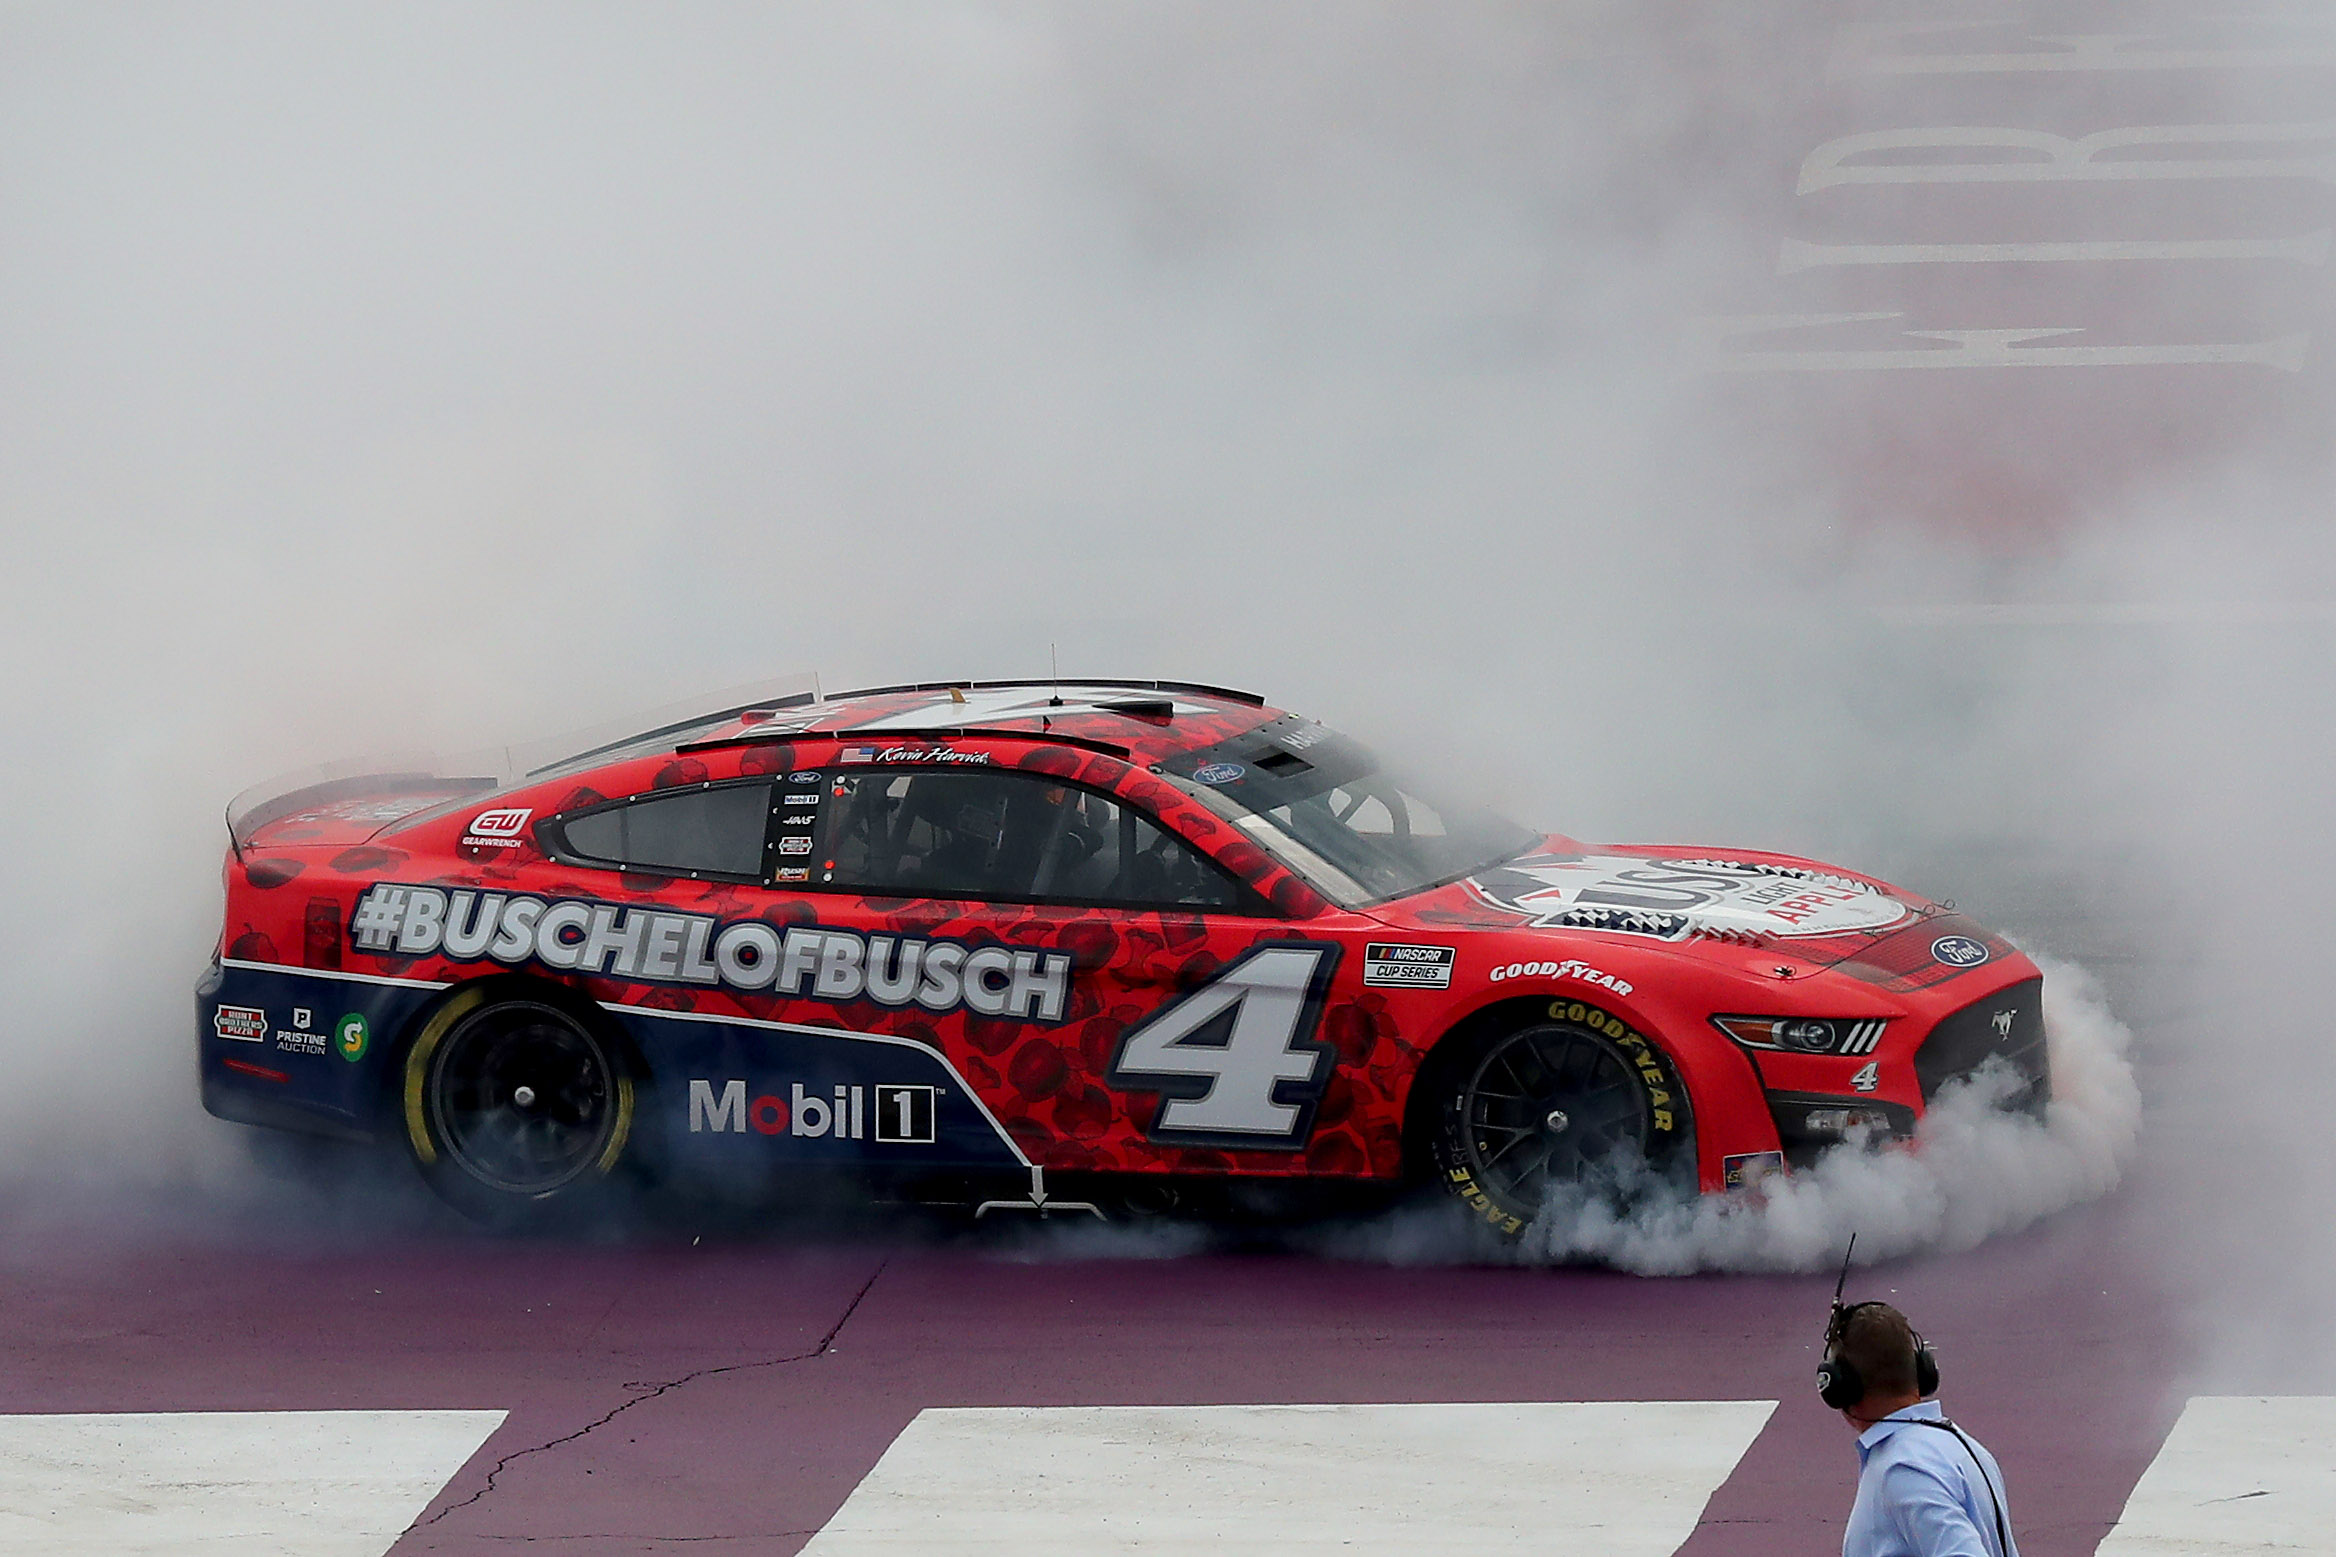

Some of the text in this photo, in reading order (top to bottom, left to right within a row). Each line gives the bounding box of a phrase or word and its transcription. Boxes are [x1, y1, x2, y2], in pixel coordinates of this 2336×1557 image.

[876, 747, 990, 764] Kevin Harvick
[1202, 766, 1238, 782] Ford
[462, 836, 522, 848] GEARWRENCH
[353, 884, 1071, 1021] #BUSCHELOFBUSCH
[1393, 947, 1442, 962] NASCAR
[1939, 940, 1983, 963] Ford
[1376, 965, 1440, 979] CUP SERIES
[1490, 959, 1634, 997] GOODYEAR
[276, 1030, 327, 1046] PRISTINE
[276, 1041, 326, 1055] AUCTION
[1115, 948, 1325, 1135] 4
[1548, 1001, 1673, 1132] GOODYEAR
[1849, 1061, 1881, 1092] 4
[689, 1079, 864, 1139] Mobil
[892, 1090, 912, 1137] 1
[1449, 1166, 1523, 1234] EAGLE
